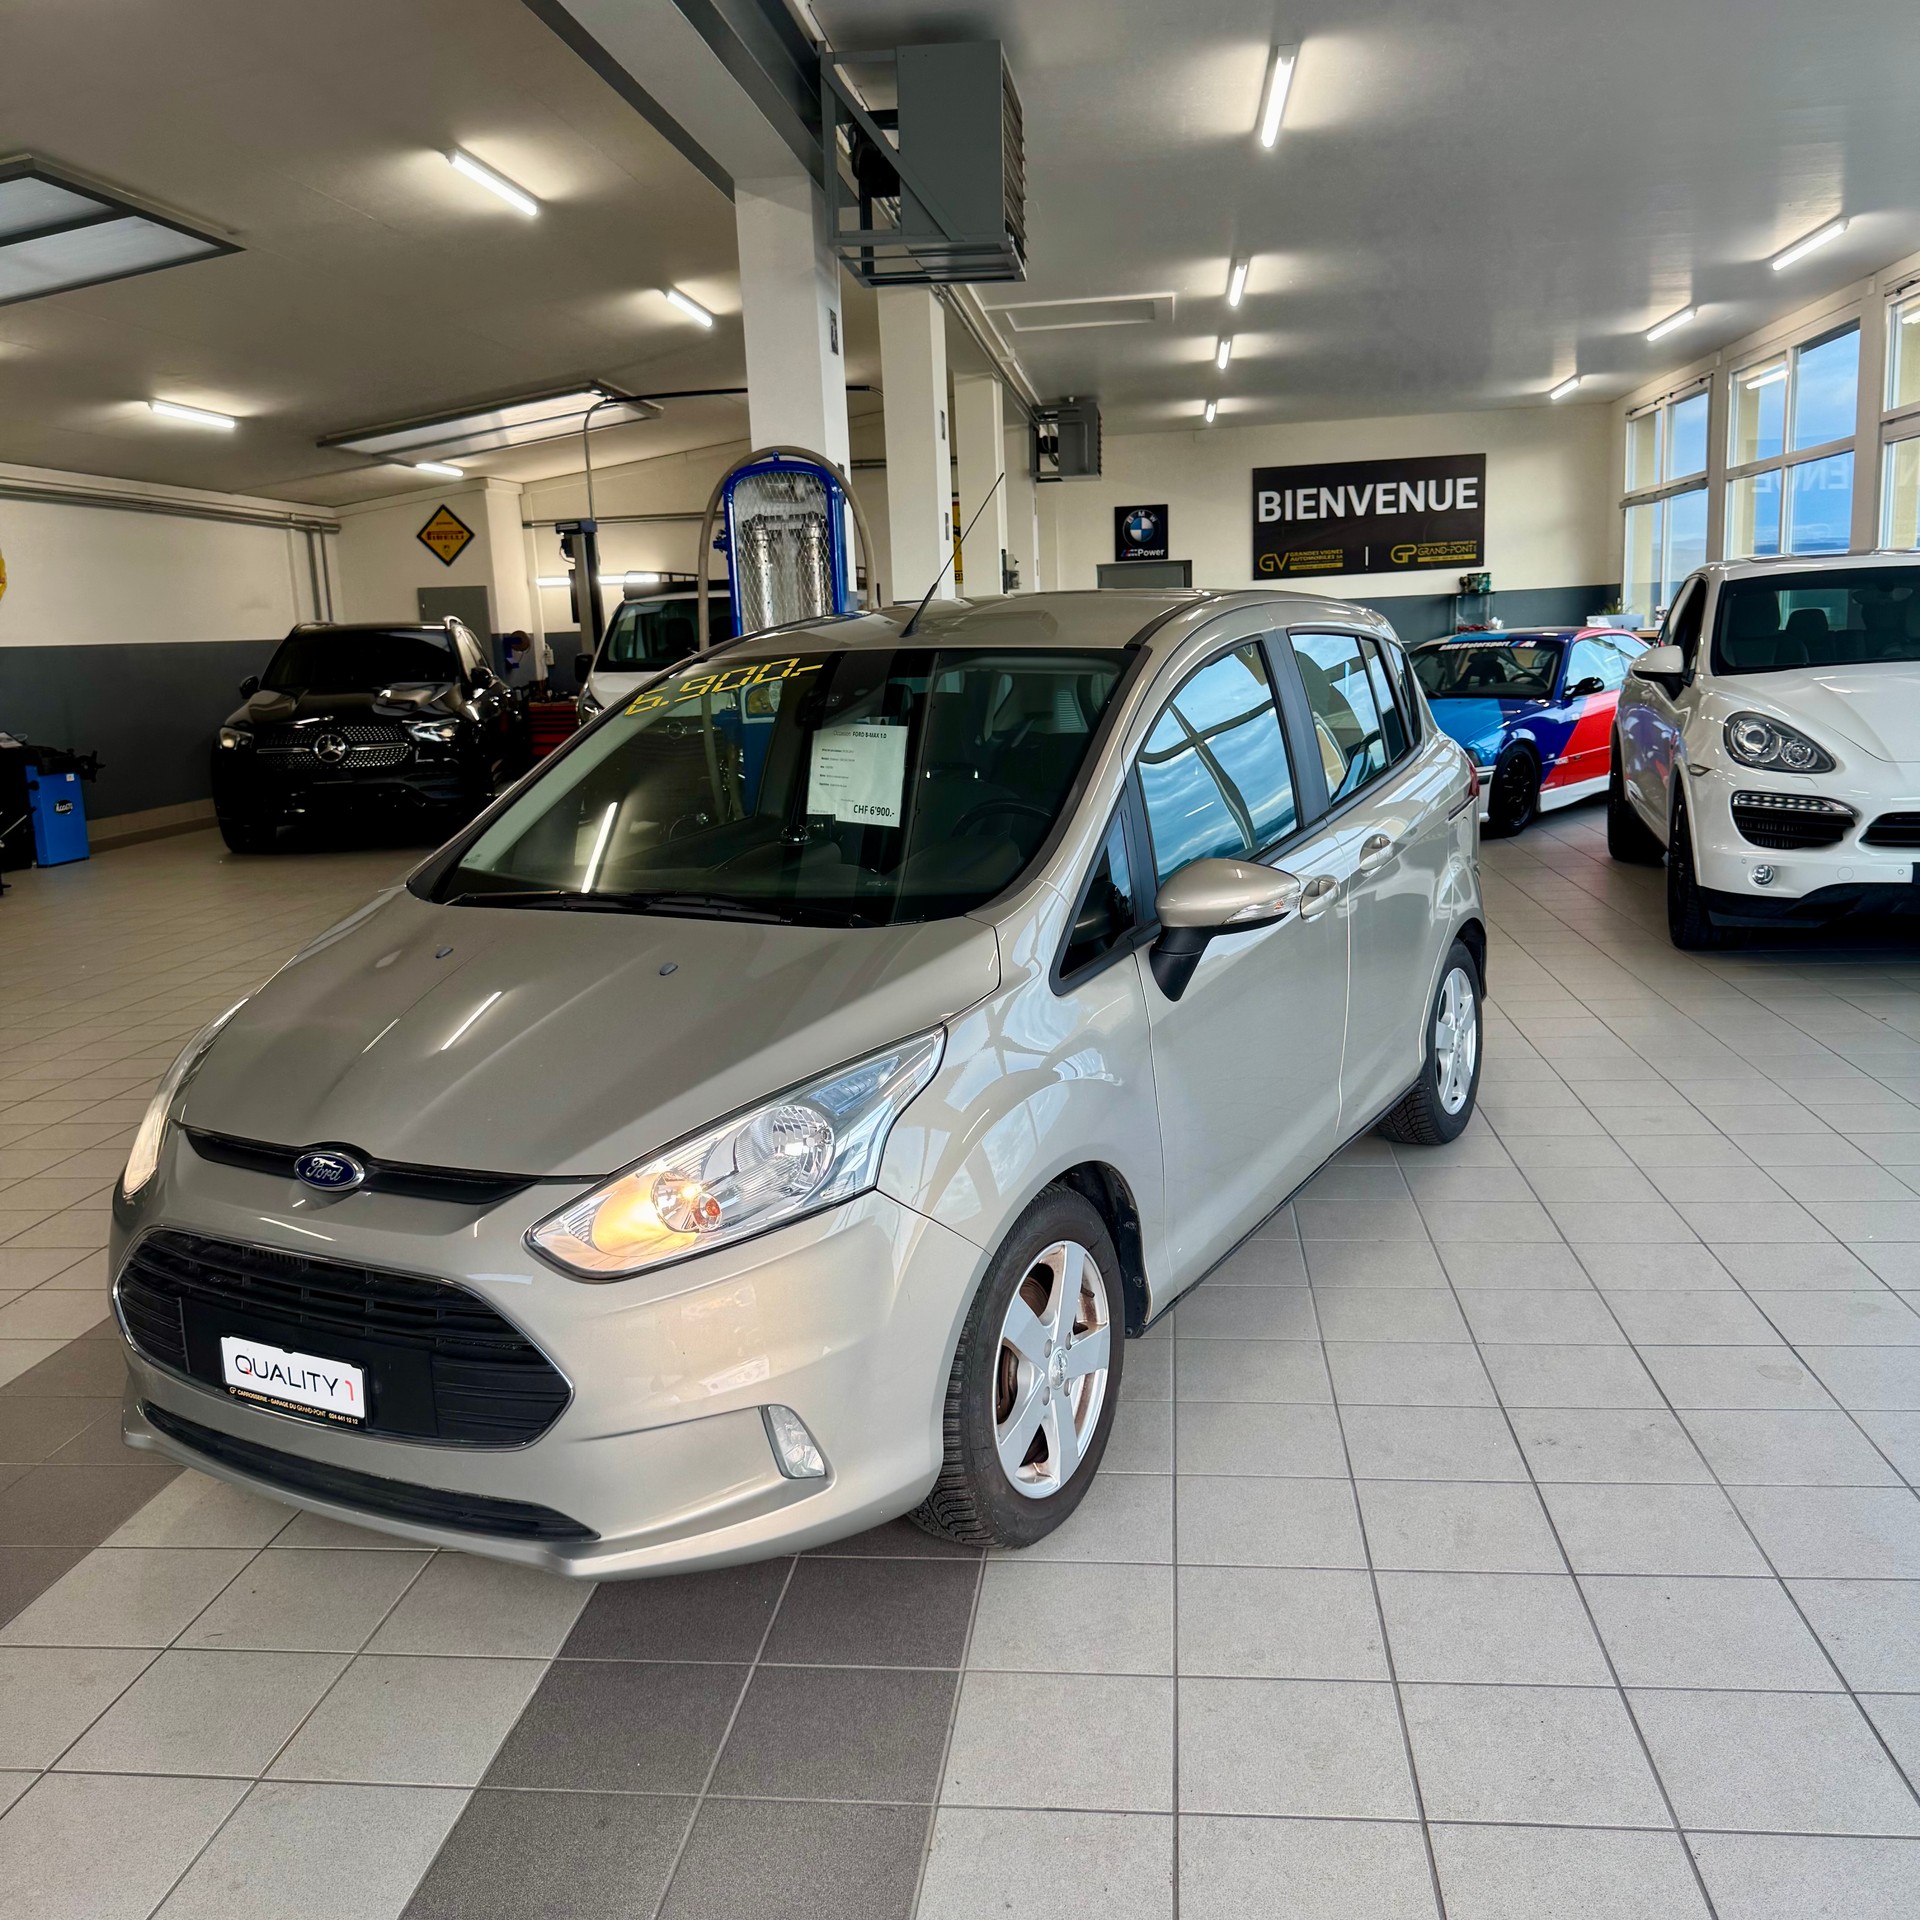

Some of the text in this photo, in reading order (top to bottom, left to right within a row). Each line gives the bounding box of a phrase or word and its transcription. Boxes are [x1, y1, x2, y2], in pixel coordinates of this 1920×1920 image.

[1258, 477, 1478, 523] BIENVENUE
[1258, 552, 1289, 572] GV
[853, 804, 868, 815] CHF
[305, 1156, 344, 1181] Ford
